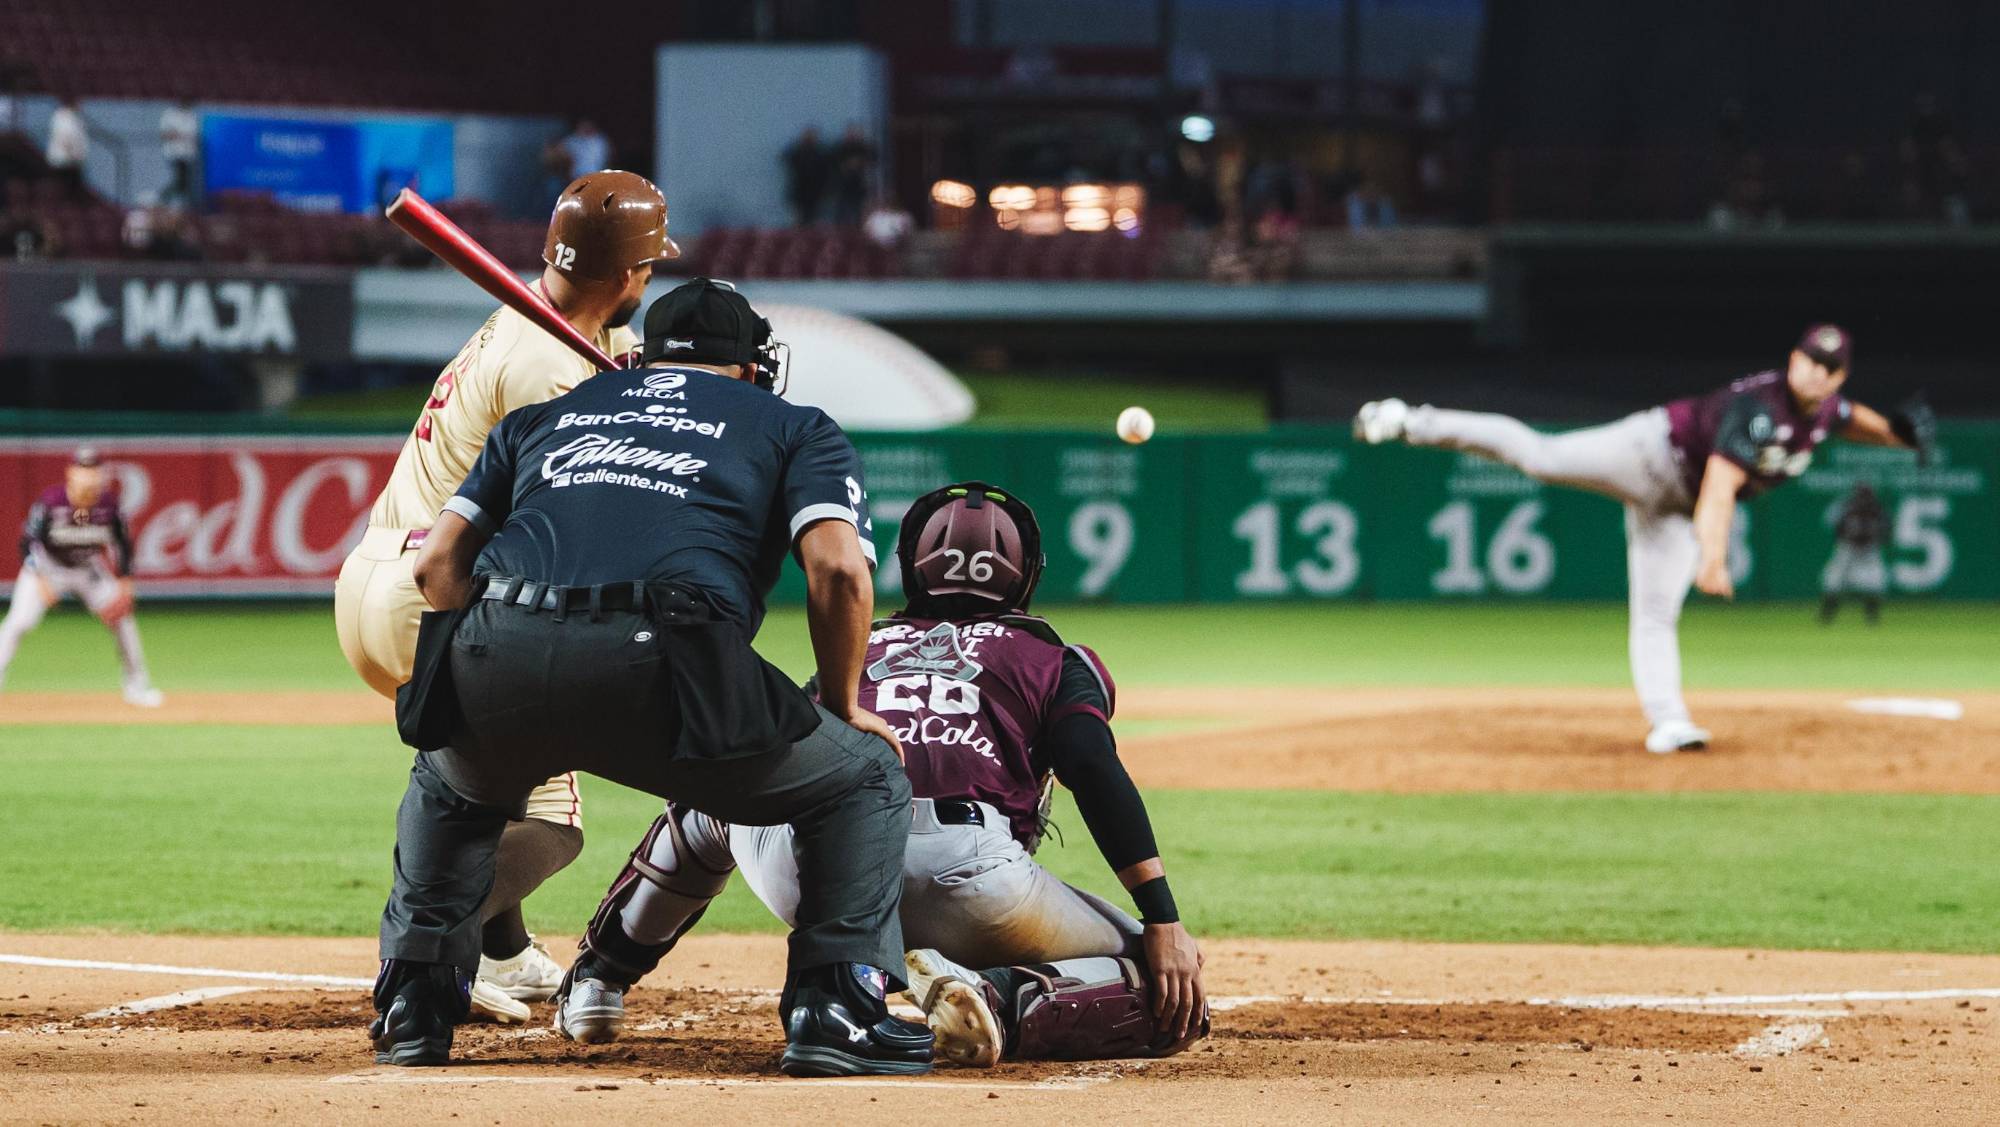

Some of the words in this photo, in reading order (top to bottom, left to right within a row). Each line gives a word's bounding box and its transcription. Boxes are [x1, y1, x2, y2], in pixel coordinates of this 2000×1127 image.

[555, 243, 576, 271] 12
[122, 280, 297, 351] MAJA
[621, 388, 686, 400] MEGA
[555, 411, 727, 439] BanCoppel
[542, 433, 708, 480] Caliente
[573, 469, 688, 498] caliente.mx
[943, 549, 994, 582] 26
[1068, 501, 1134, 597] 9
[1232, 502, 1361, 595] 13
[1427, 502, 1556, 593] 16
